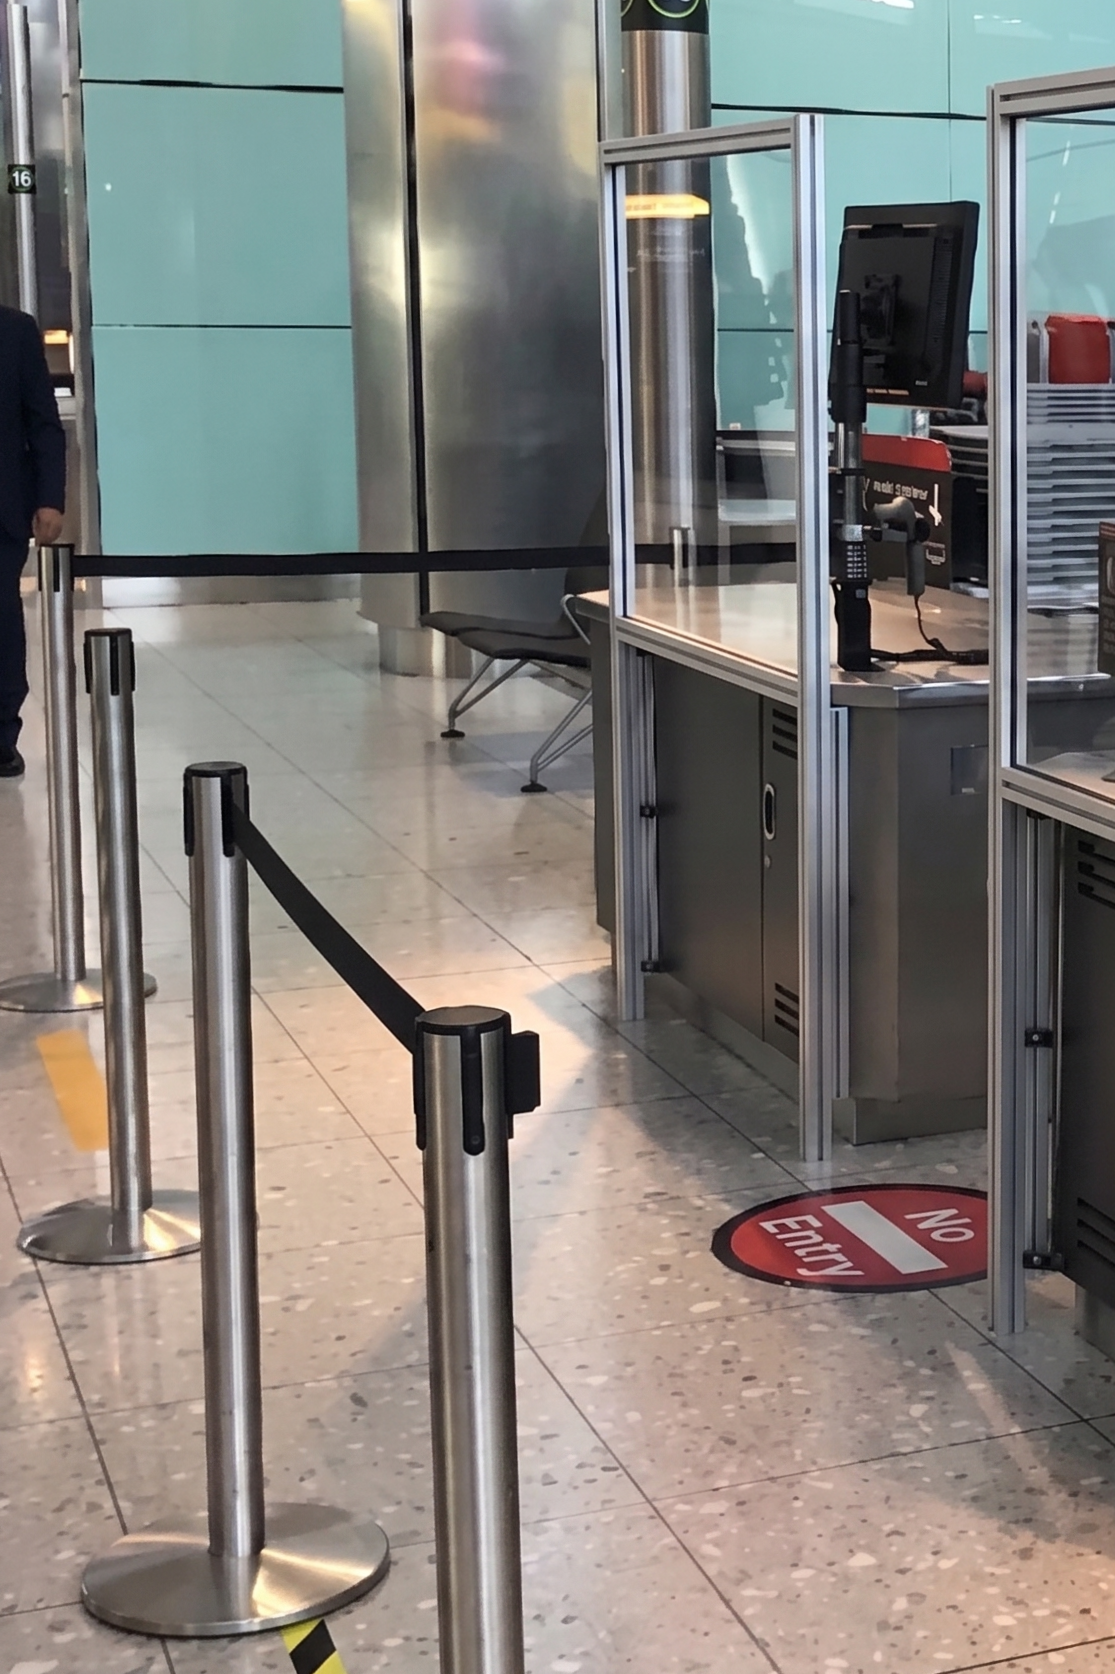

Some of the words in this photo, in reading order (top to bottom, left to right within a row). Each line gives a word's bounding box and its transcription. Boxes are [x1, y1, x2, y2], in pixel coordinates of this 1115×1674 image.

[12, 170, 31, 187] 16
[904, 1208, 975, 1243] No
[758, 1214, 865, 1276] Entry
